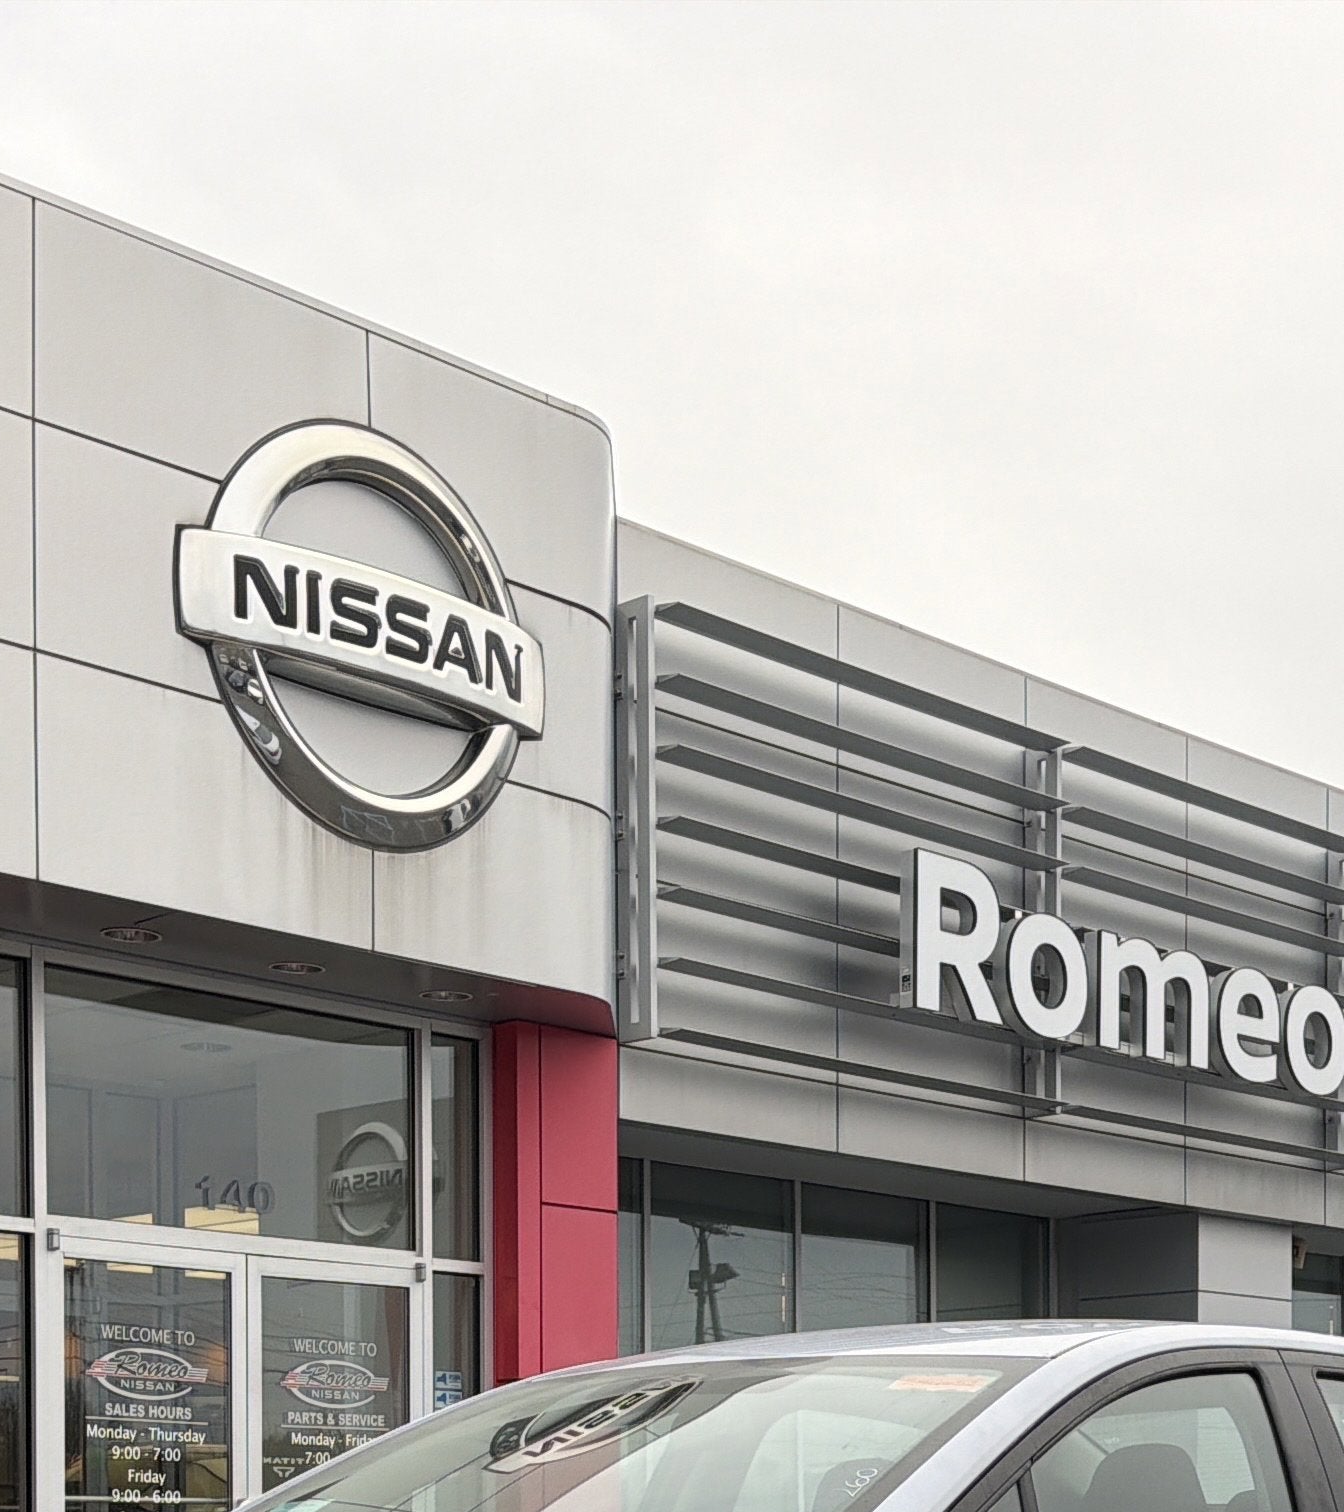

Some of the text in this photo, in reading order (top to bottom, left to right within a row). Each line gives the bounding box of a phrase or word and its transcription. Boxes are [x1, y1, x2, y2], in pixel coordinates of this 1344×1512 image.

[232, 553, 524, 704] NISSAN
[100, 1323, 196, 1346] WELCOME TO
[293, 1338, 377, 1357] WELCOME TO
[114, 1350, 189, 1379] Romeo
[305, 1362, 373, 1388] Romeo
[120, 1378, 175, 1392] NISSAN
[311, 1389, 360, 1401] NISSAN
[104, 1402, 193, 1420] SALES HOURS
[287, 1411, 385, 1427] PARTS & SERVICE
[86, 1424, 138, 1443] Monday
[148, 1427, 207, 1445] Thursday
[291, 1432, 336, 1449] Monday
[111, 1445, 141, 1460] 9:00
[153, 1447, 181, 1462] 7:00
[304, 1451, 331, 1465] 7:00
[127, 1468, 166, 1486] Friday
[111, 1488, 141, 1503] 9:00
[152, 1490, 181, 1504] 6:00
